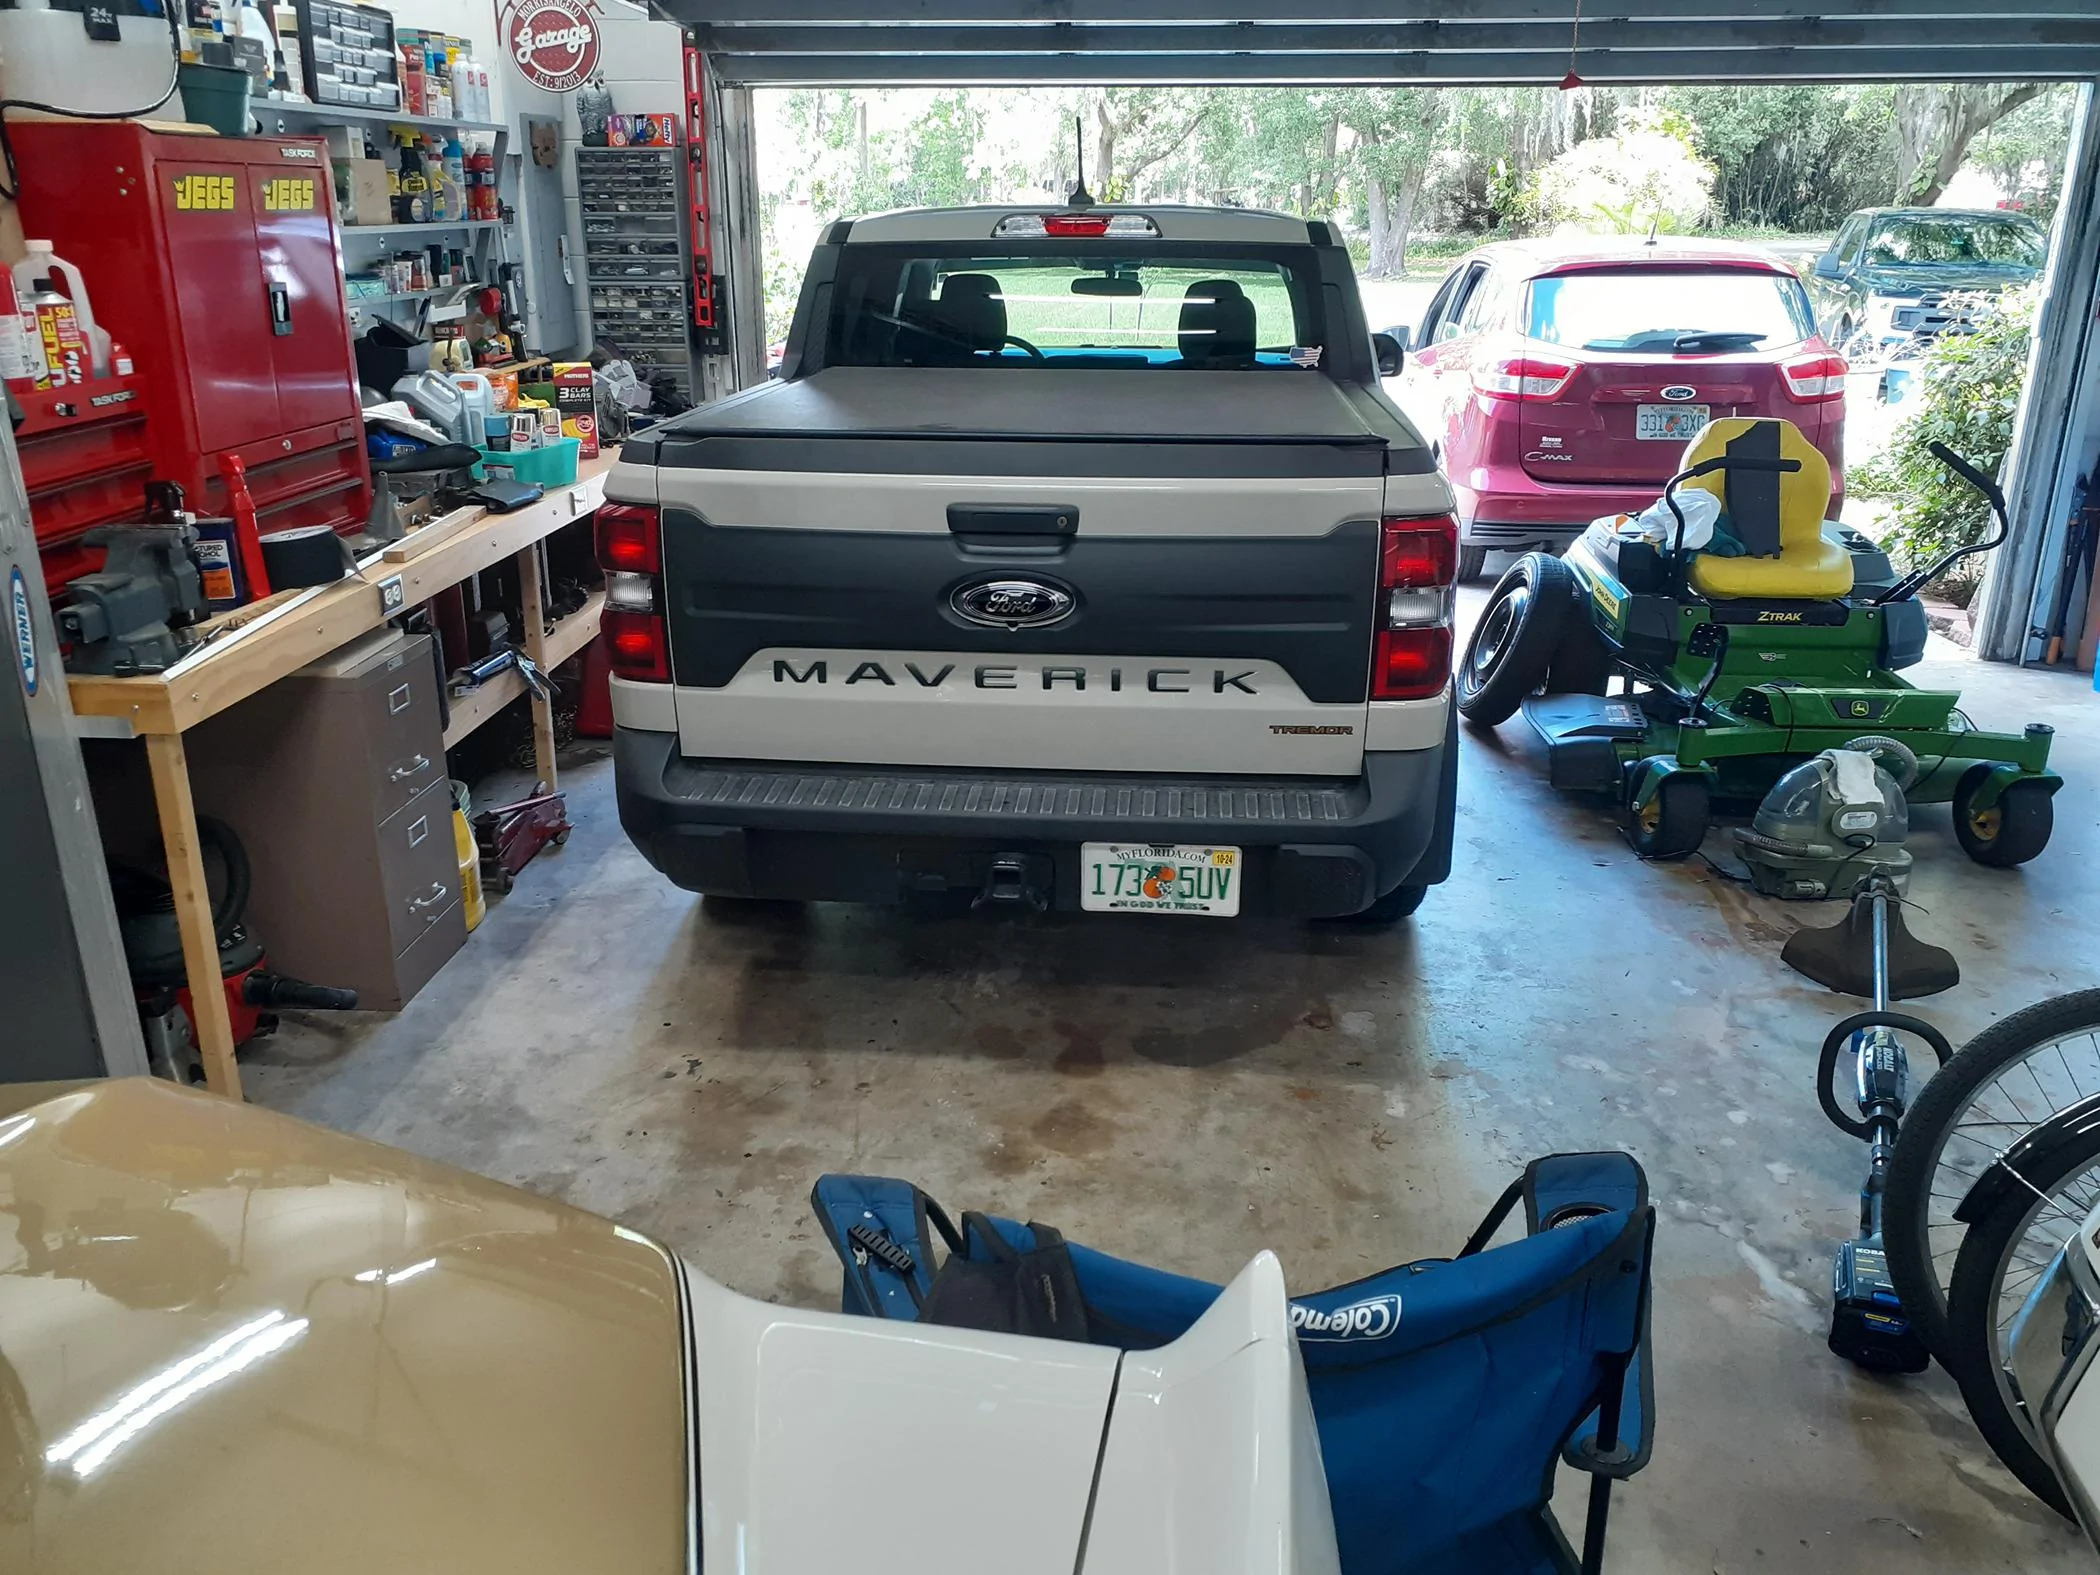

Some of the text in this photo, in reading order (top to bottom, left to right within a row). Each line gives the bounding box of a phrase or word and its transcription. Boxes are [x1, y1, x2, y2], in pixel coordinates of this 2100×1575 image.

[515, 25, 592, 64] Garage
[177, 175, 234, 209] JEGS
[265, 179, 314, 210] JEGS
[559, 387, 569, 399] 3
[1668, 388, 1689, 397] Ford
[1641, 414, 1664, 431] 331
[1524, 451, 1572, 461] C-MAX
[985, 590, 1036, 613] Ford
[1757, 611, 1803, 621] ZTRAK
[15, 591, 34, 669] WERNER
[773, 659, 1261, 695] MAVERICK
[1269, 725, 1353, 735] TREMOR
[1116, 847, 1206, 863] MYFLORIDA.COM
[1092, 863, 1231, 900] 173 5UV
[1130, 900, 1154, 908] GOD
[1156, 901, 1171, 909] WE
[1855, 1248, 1885, 1256] KOBA
[1289, 1303, 1390, 1338] Colema
